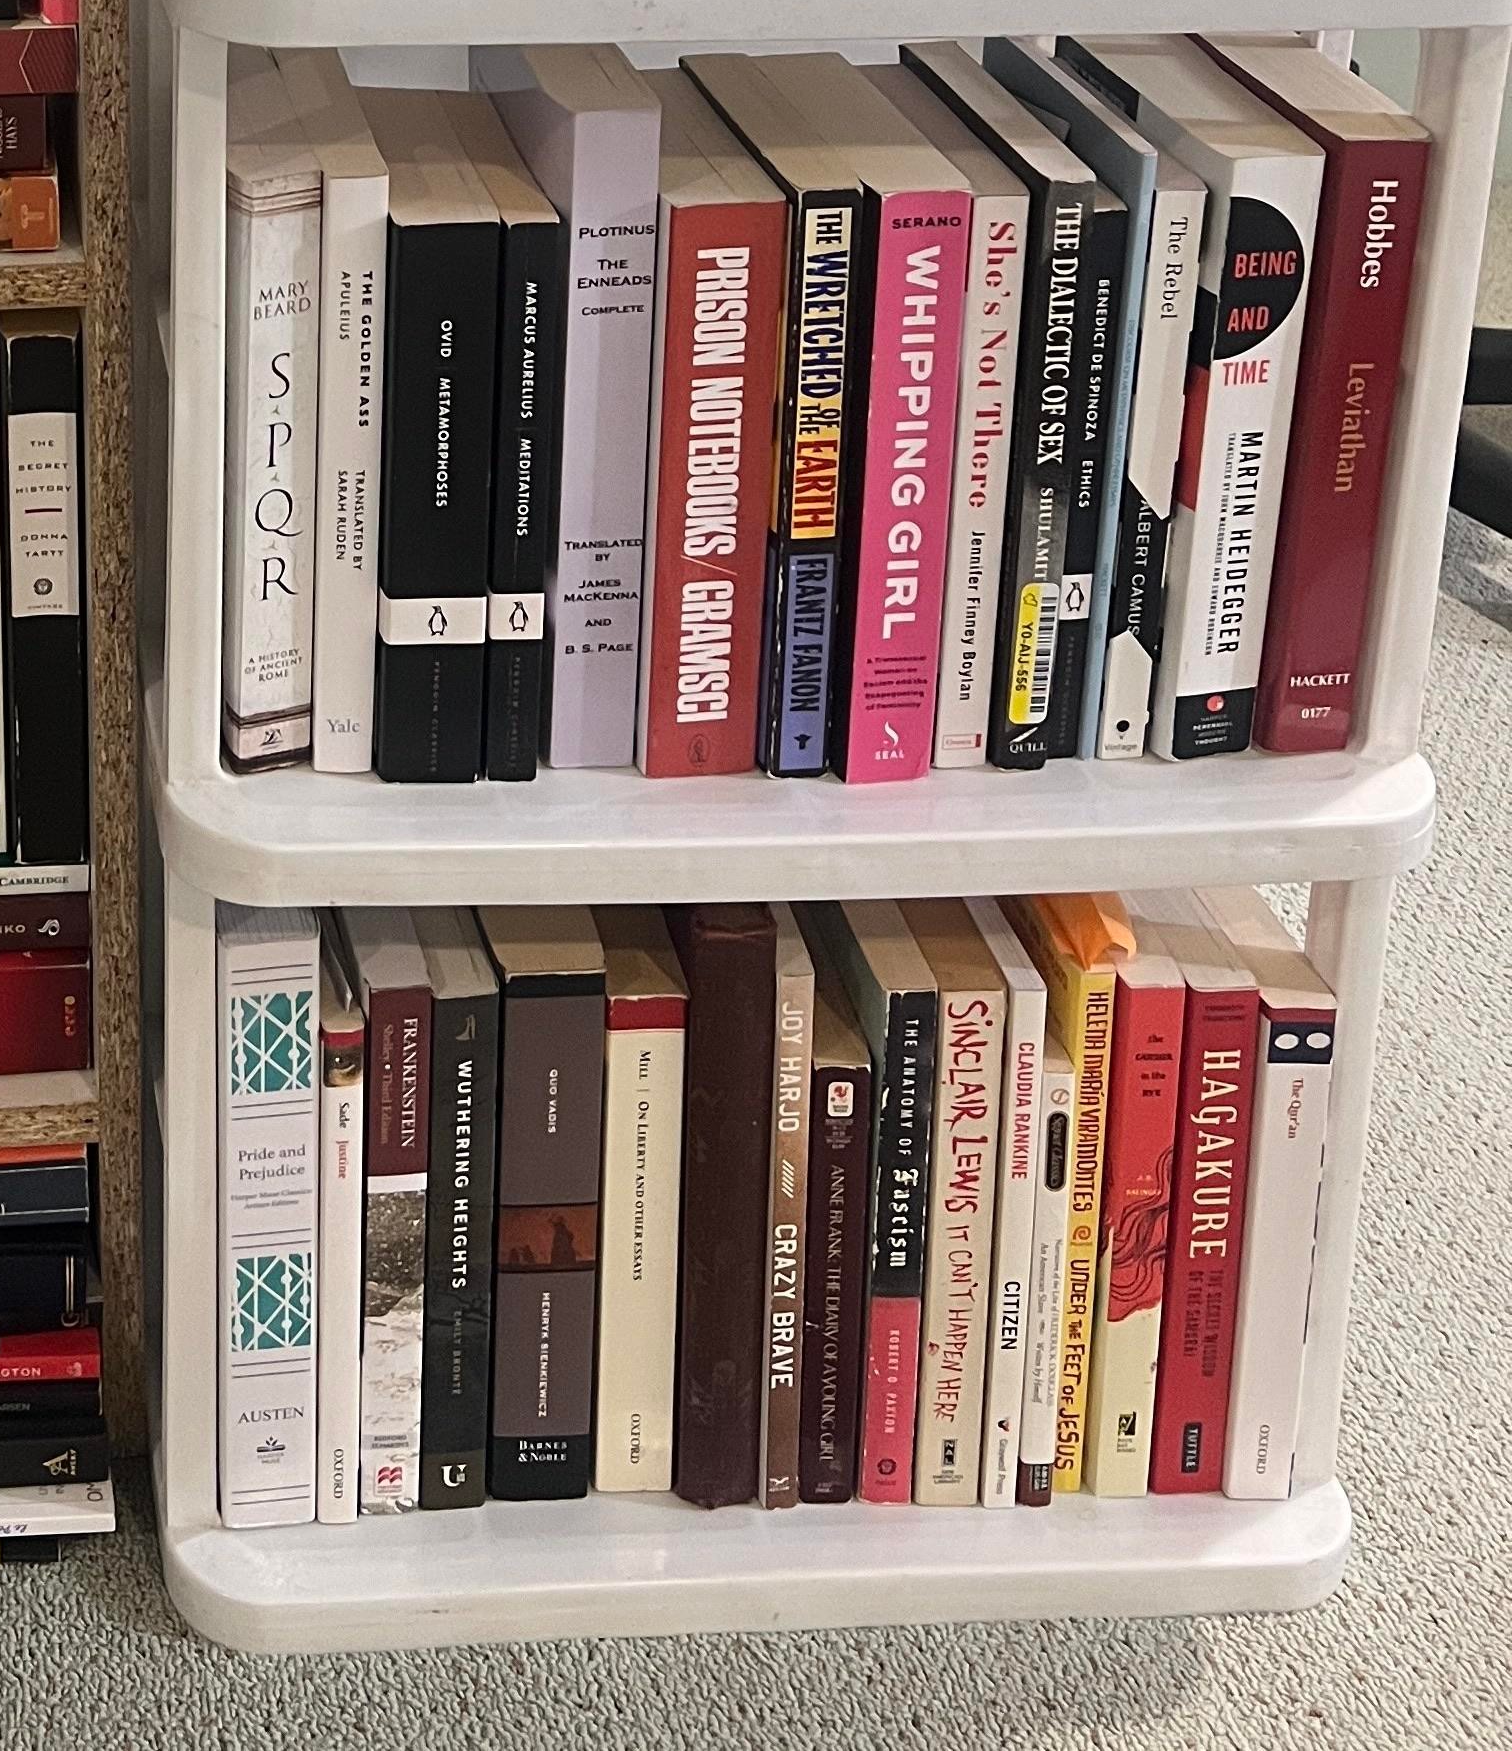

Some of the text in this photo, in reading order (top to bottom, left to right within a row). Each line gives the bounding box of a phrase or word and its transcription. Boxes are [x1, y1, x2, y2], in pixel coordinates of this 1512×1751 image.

[579, 225, 655, 238] PLOTINUS
[892, 216, 962, 230] SERANO
[1360, 180, 1399, 288] Hobbes
[1234, 251, 1297, 278] BEING
[259, 280, 309, 301] MARY
[577, 273, 652, 288] ENNEADS
[254, 296, 312, 319] BEARD
[1227, 307, 1269, 332] AND
[441, 319, 452, 358] OVID
[1222, 362, 1269, 386] TIME
[684, 246, 750, 557] PRISON NOTEBOOKS
[1335, 362, 1376, 493] Leviathan
[435, 378, 451, 508] METAMORPHOSES
[882, 245, 941, 639] WHIPPING GIRL
[676, 581, 734, 723] GRAMSCI
[1290, 672, 1351, 687] HACKETT
[1301, 706, 1331, 719] 0177
[326, 718, 360, 734] Yale
[0, 875, 69, 888] CAMBRIDGE
[778, 1002, 803, 1133] JOY HARJO
[238, 1145, 306, 1163] Pride and
[1189, 1049, 1241, 1259] HAGAKURE
[238, 1164, 306, 1183] Prejudice
[452, 1060, 472, 1289] WUTHERING HEIGHTS
[770, 1224, 798, 1390] CRAZY BRAVE
[1001, 1281, 1019, 1351] CITIZEN
[238, 1407, 304, 1423] AUSTEN
[1255, 1425, 1269, 1475] OXFORD
